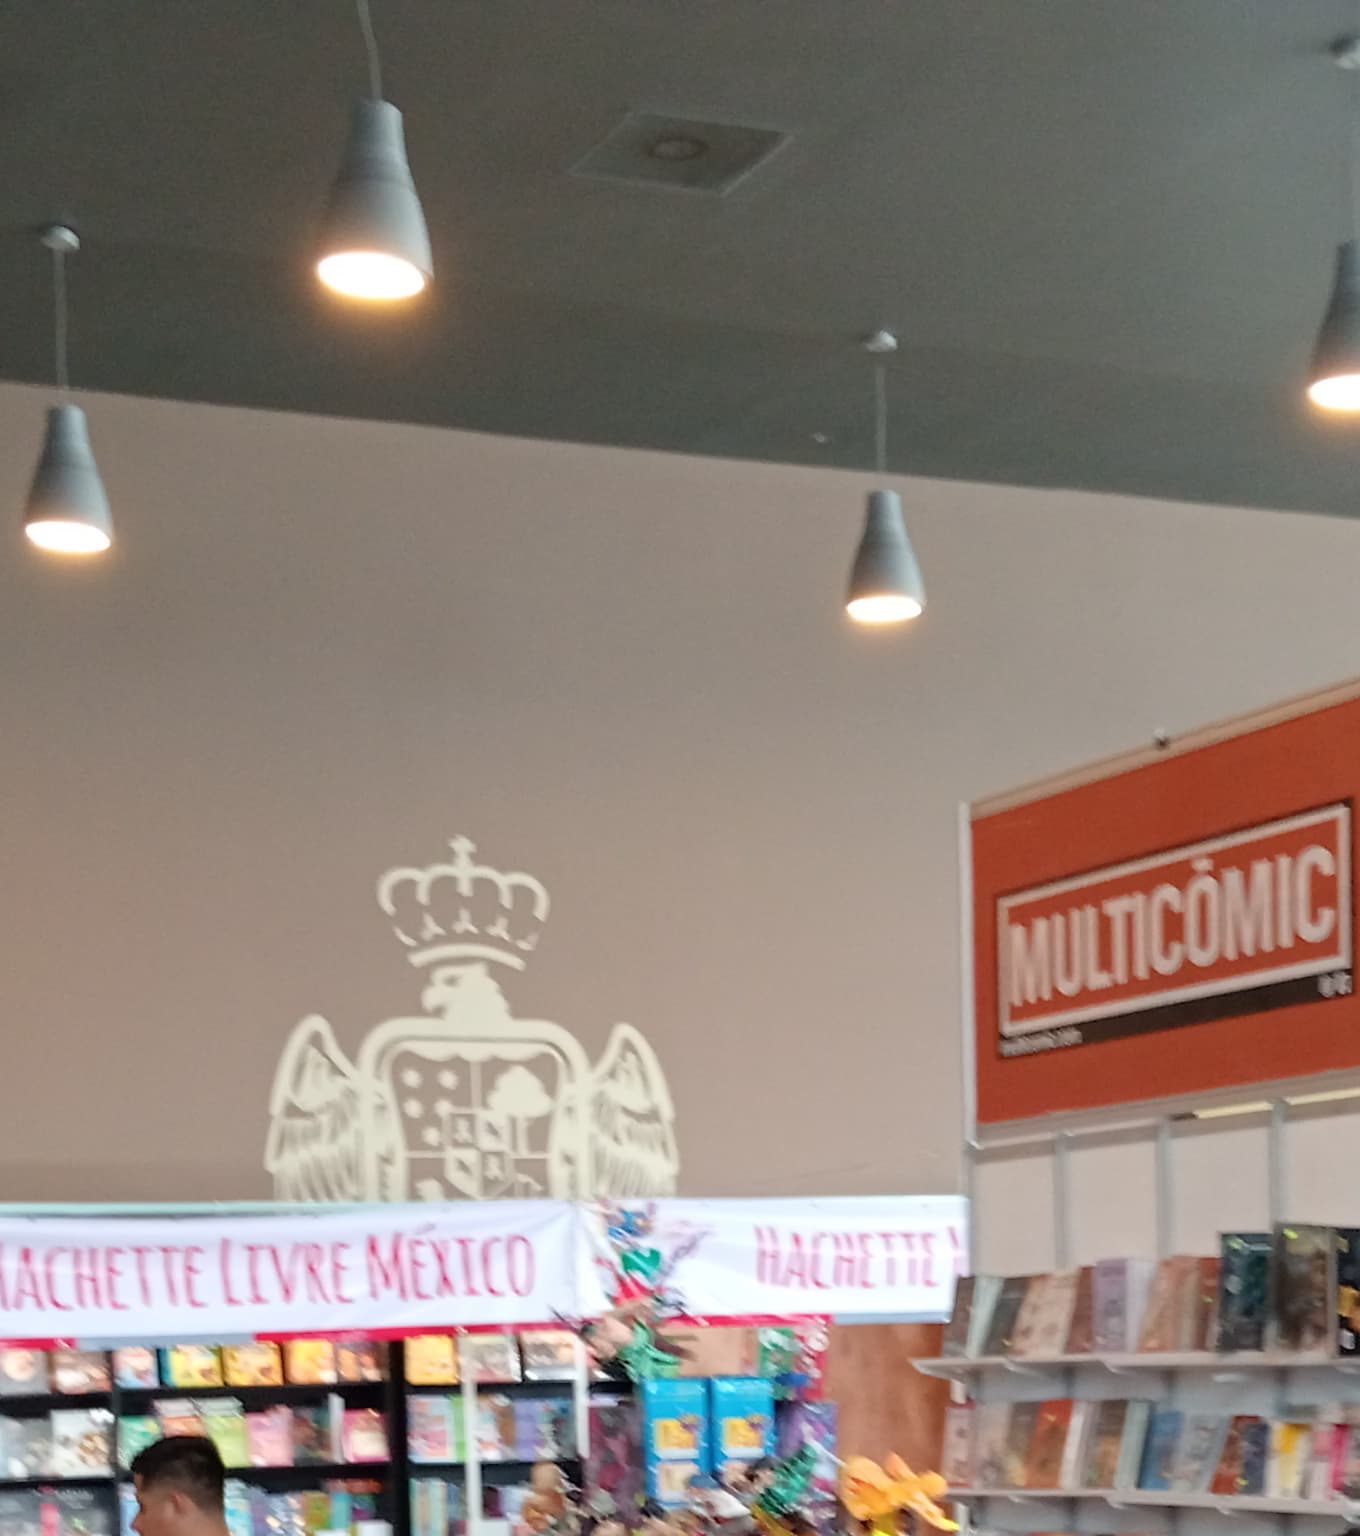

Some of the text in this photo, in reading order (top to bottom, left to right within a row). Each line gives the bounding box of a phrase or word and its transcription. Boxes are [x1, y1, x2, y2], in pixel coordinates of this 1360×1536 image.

[219, 1236, 356, 1307] LIVRE
[364, 1222, 536, 1302] MÉXICO
[753, 1225, 940, 1290] HACHETTE
